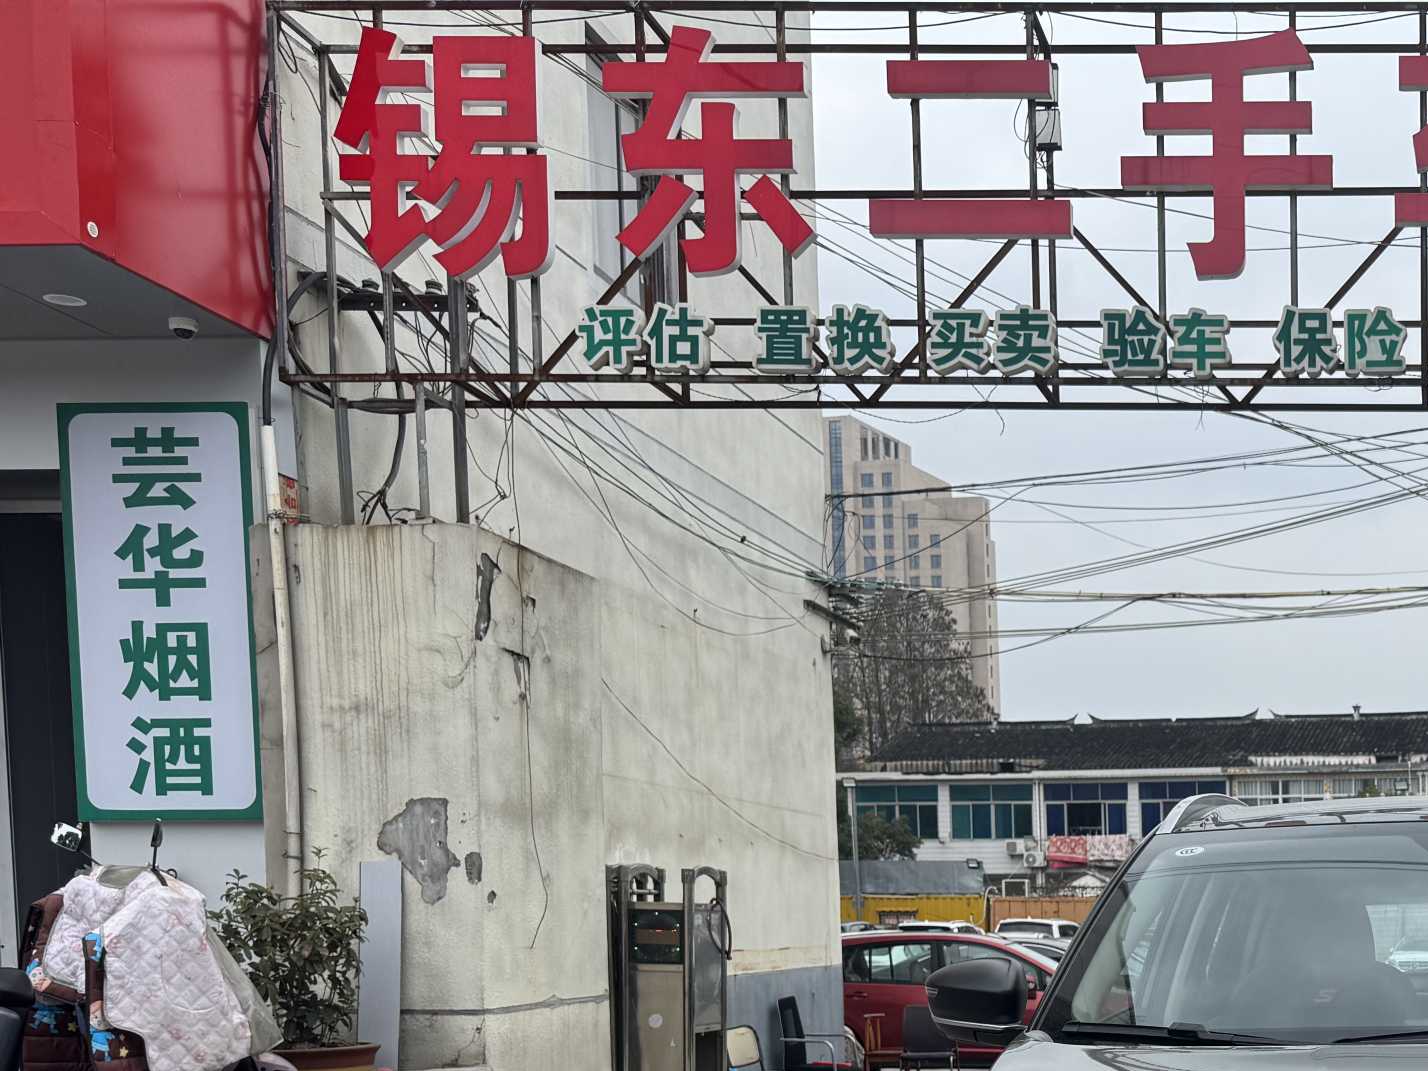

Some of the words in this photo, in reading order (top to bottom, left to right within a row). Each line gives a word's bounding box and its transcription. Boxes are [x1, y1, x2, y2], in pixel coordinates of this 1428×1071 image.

[577, 304, 704, 366] 评估
[756, 306, 887, 367] 置换
[930, 306, 1052, 367] 买卖
[1102, 308, 1226, 371] 验车
[1278, 306, 1405, 370] 保险
[110, 426, 214, 797] 芸华烟酒
